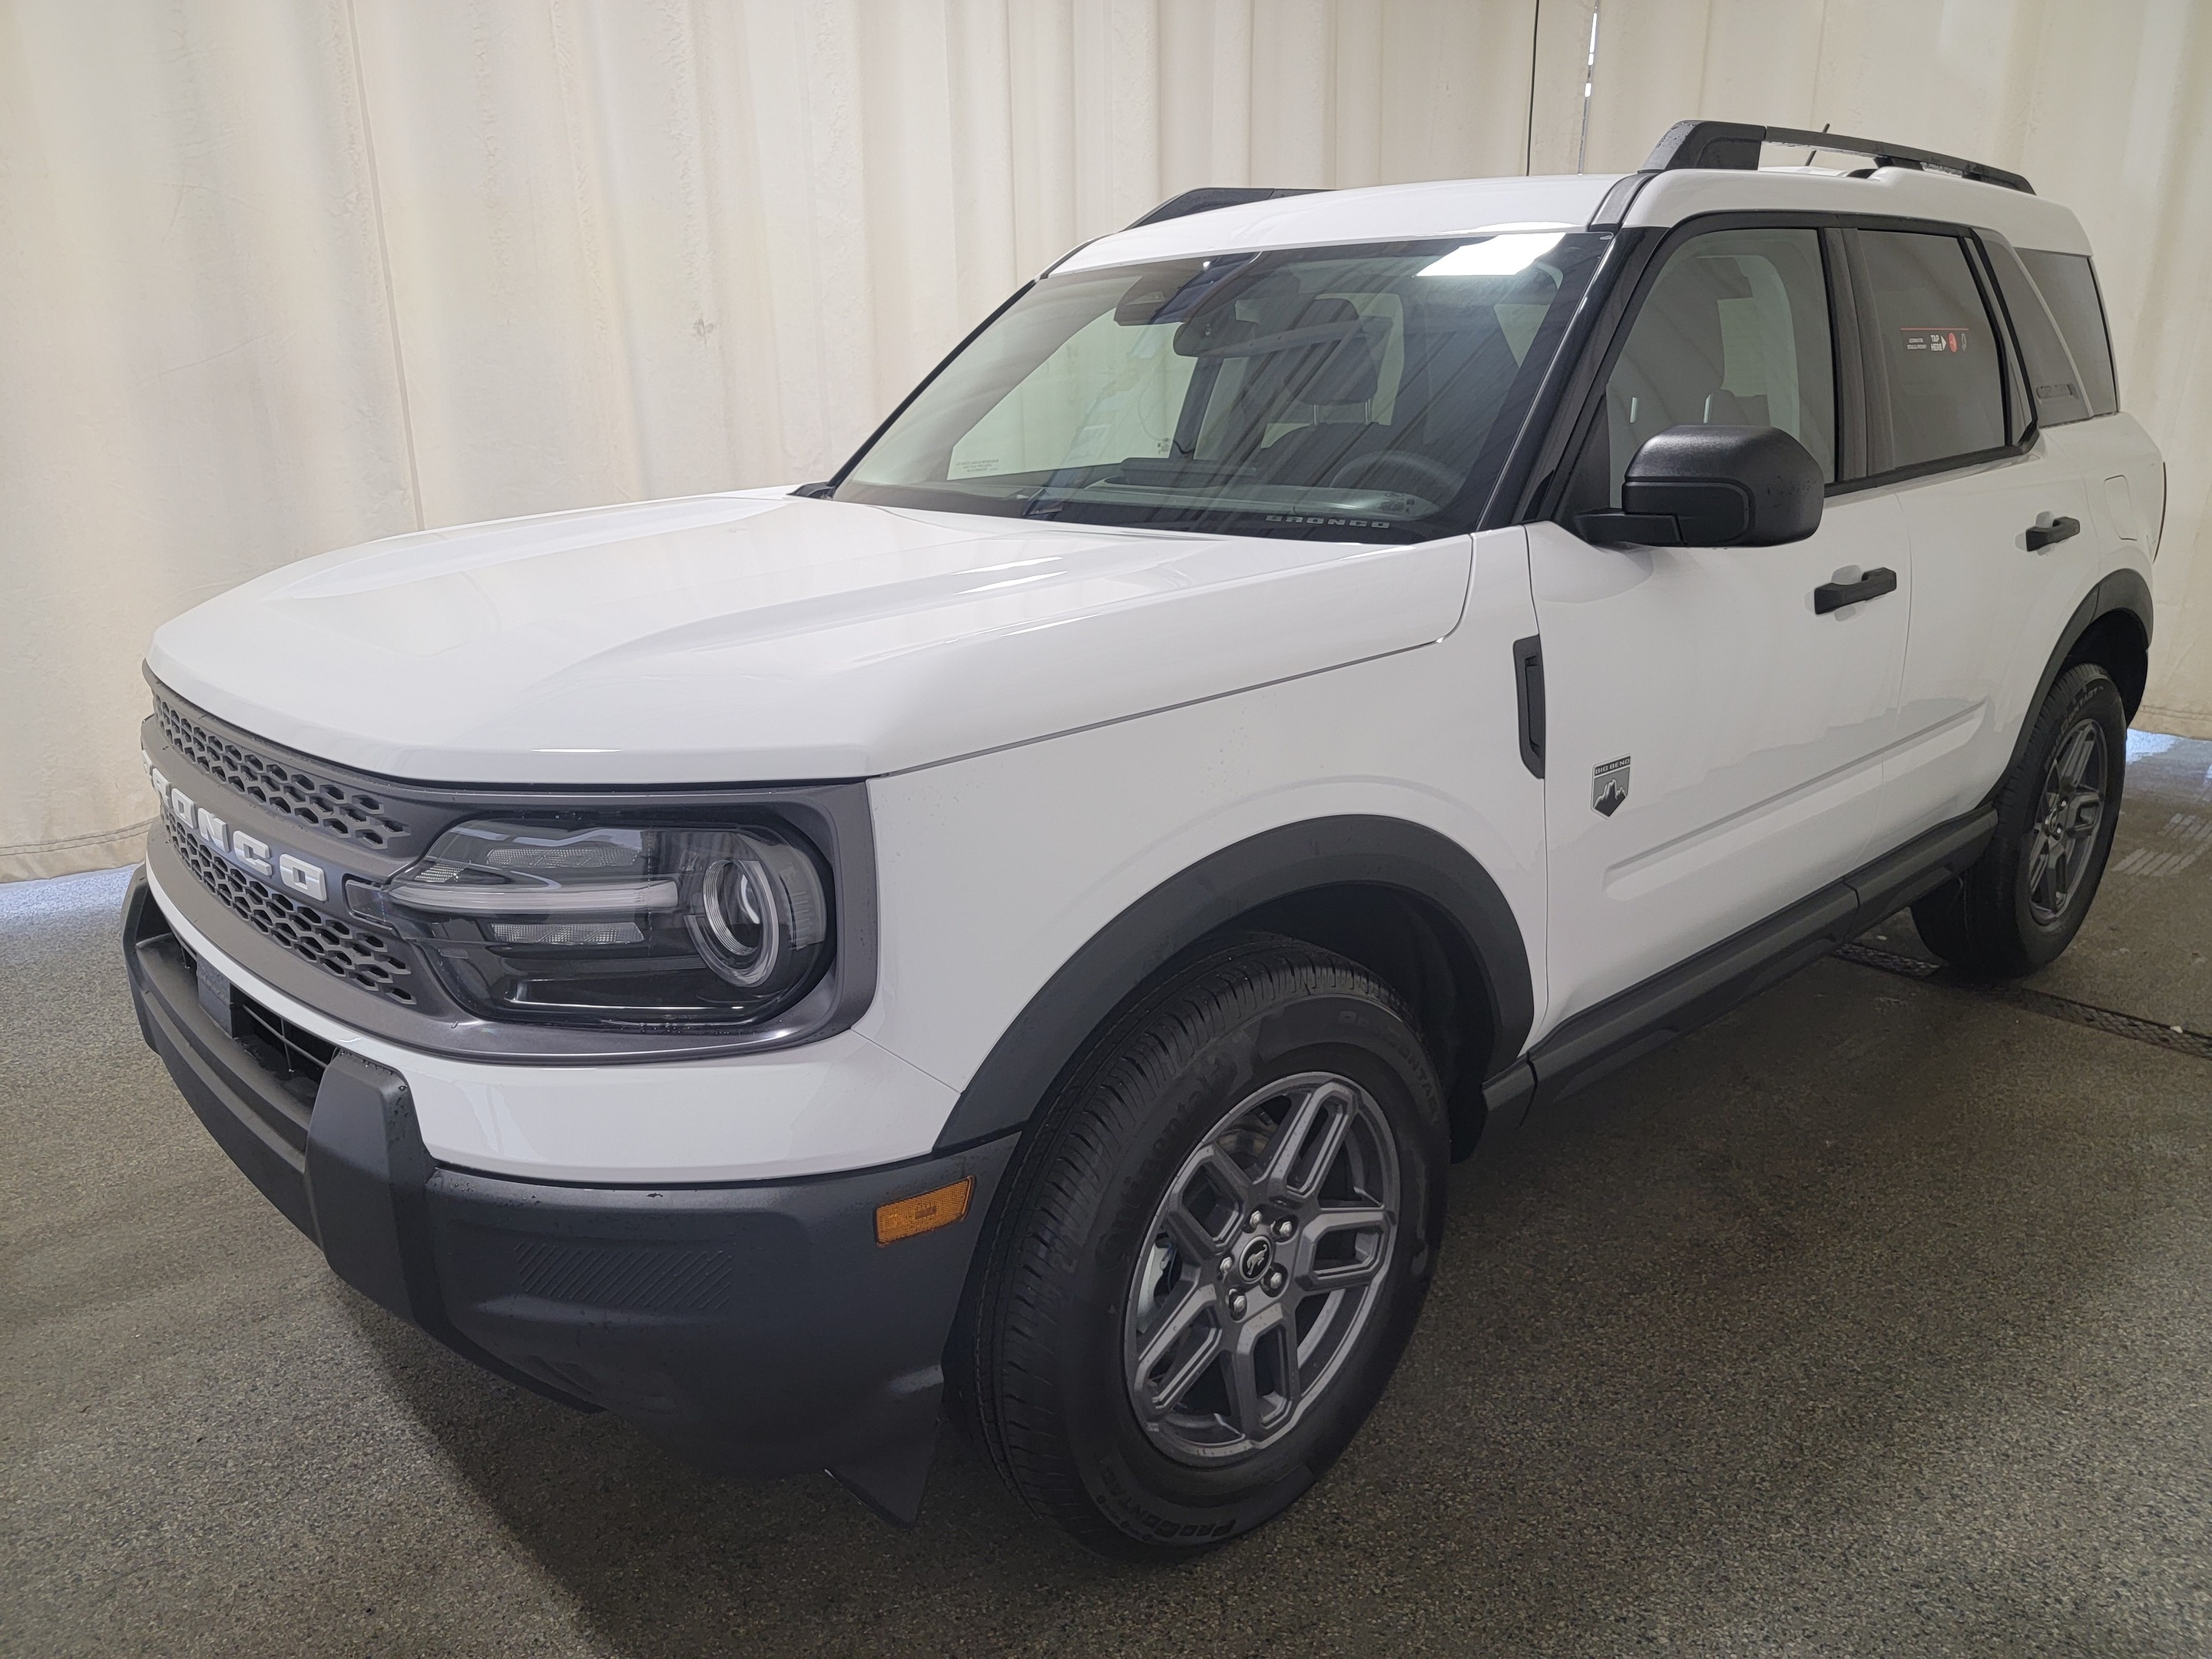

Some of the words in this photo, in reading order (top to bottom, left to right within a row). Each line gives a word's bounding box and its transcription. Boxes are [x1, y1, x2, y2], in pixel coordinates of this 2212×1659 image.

[1265, 515, 1389, 528] BRONCO
[1596, 766, 1608, 774] BIG
[1610, 758, 1630, 769] BEND
